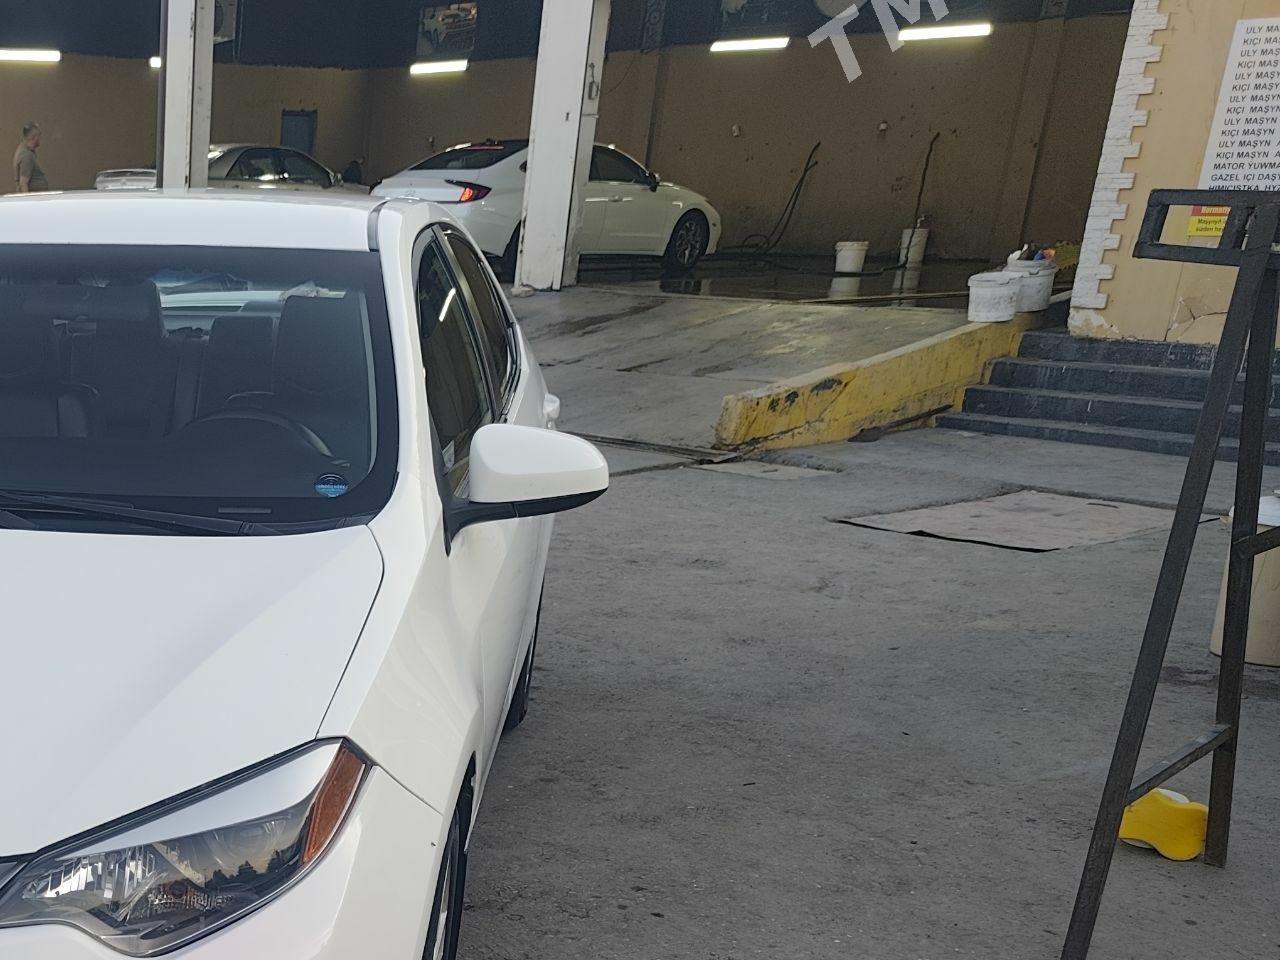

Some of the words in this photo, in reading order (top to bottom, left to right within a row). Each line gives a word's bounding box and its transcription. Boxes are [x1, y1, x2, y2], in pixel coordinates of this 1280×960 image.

[1246, 25, 1263, 34] ULY
[1240, 49, 1258, 57] ULY
[1235, 72, 1252, 80] ULY
[1229, 95, 1247, 103] ULY
[1224, 117, 1241, 126] ULY
[1244, 116, 1278, 126] MAŞYN
[1242, 128, 1275, 137] MAŞYN
[1218, 140, 1236, 148] ULY
[1238, 139, 1271, 148] MAŞYN
[1213, 162, 1245, 170] MATOR
[1211, 173, 1241, 182] GAZEL
